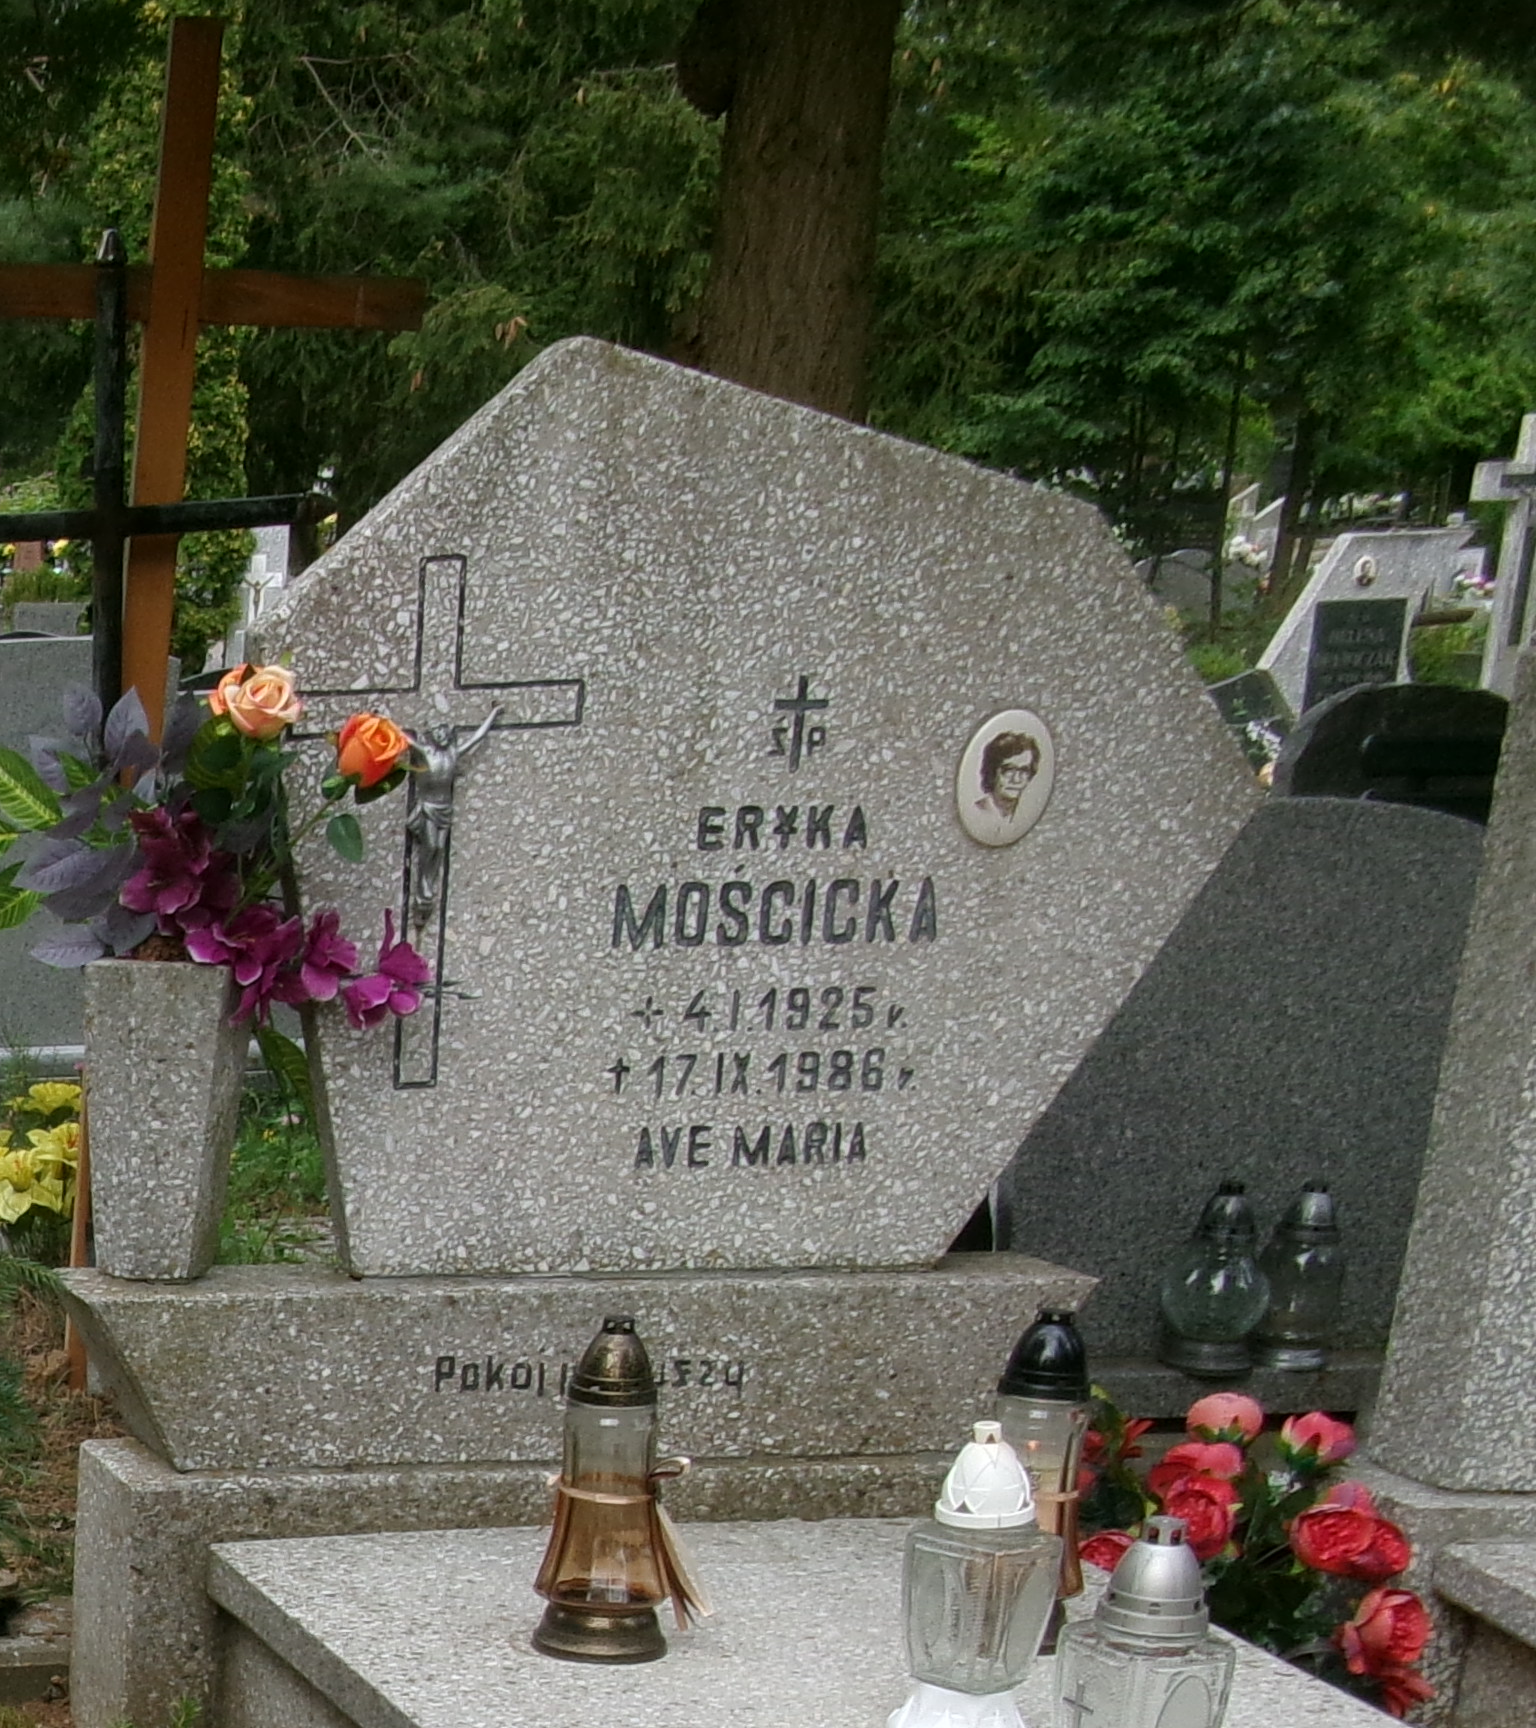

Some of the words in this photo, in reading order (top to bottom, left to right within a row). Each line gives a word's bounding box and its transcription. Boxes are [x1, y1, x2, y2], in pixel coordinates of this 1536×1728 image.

[611, 864, 938, 951] MOŚCICKA
[634, 1125, 712, 1169] AVE
[731, 1121, 867, 1167] MARIA
